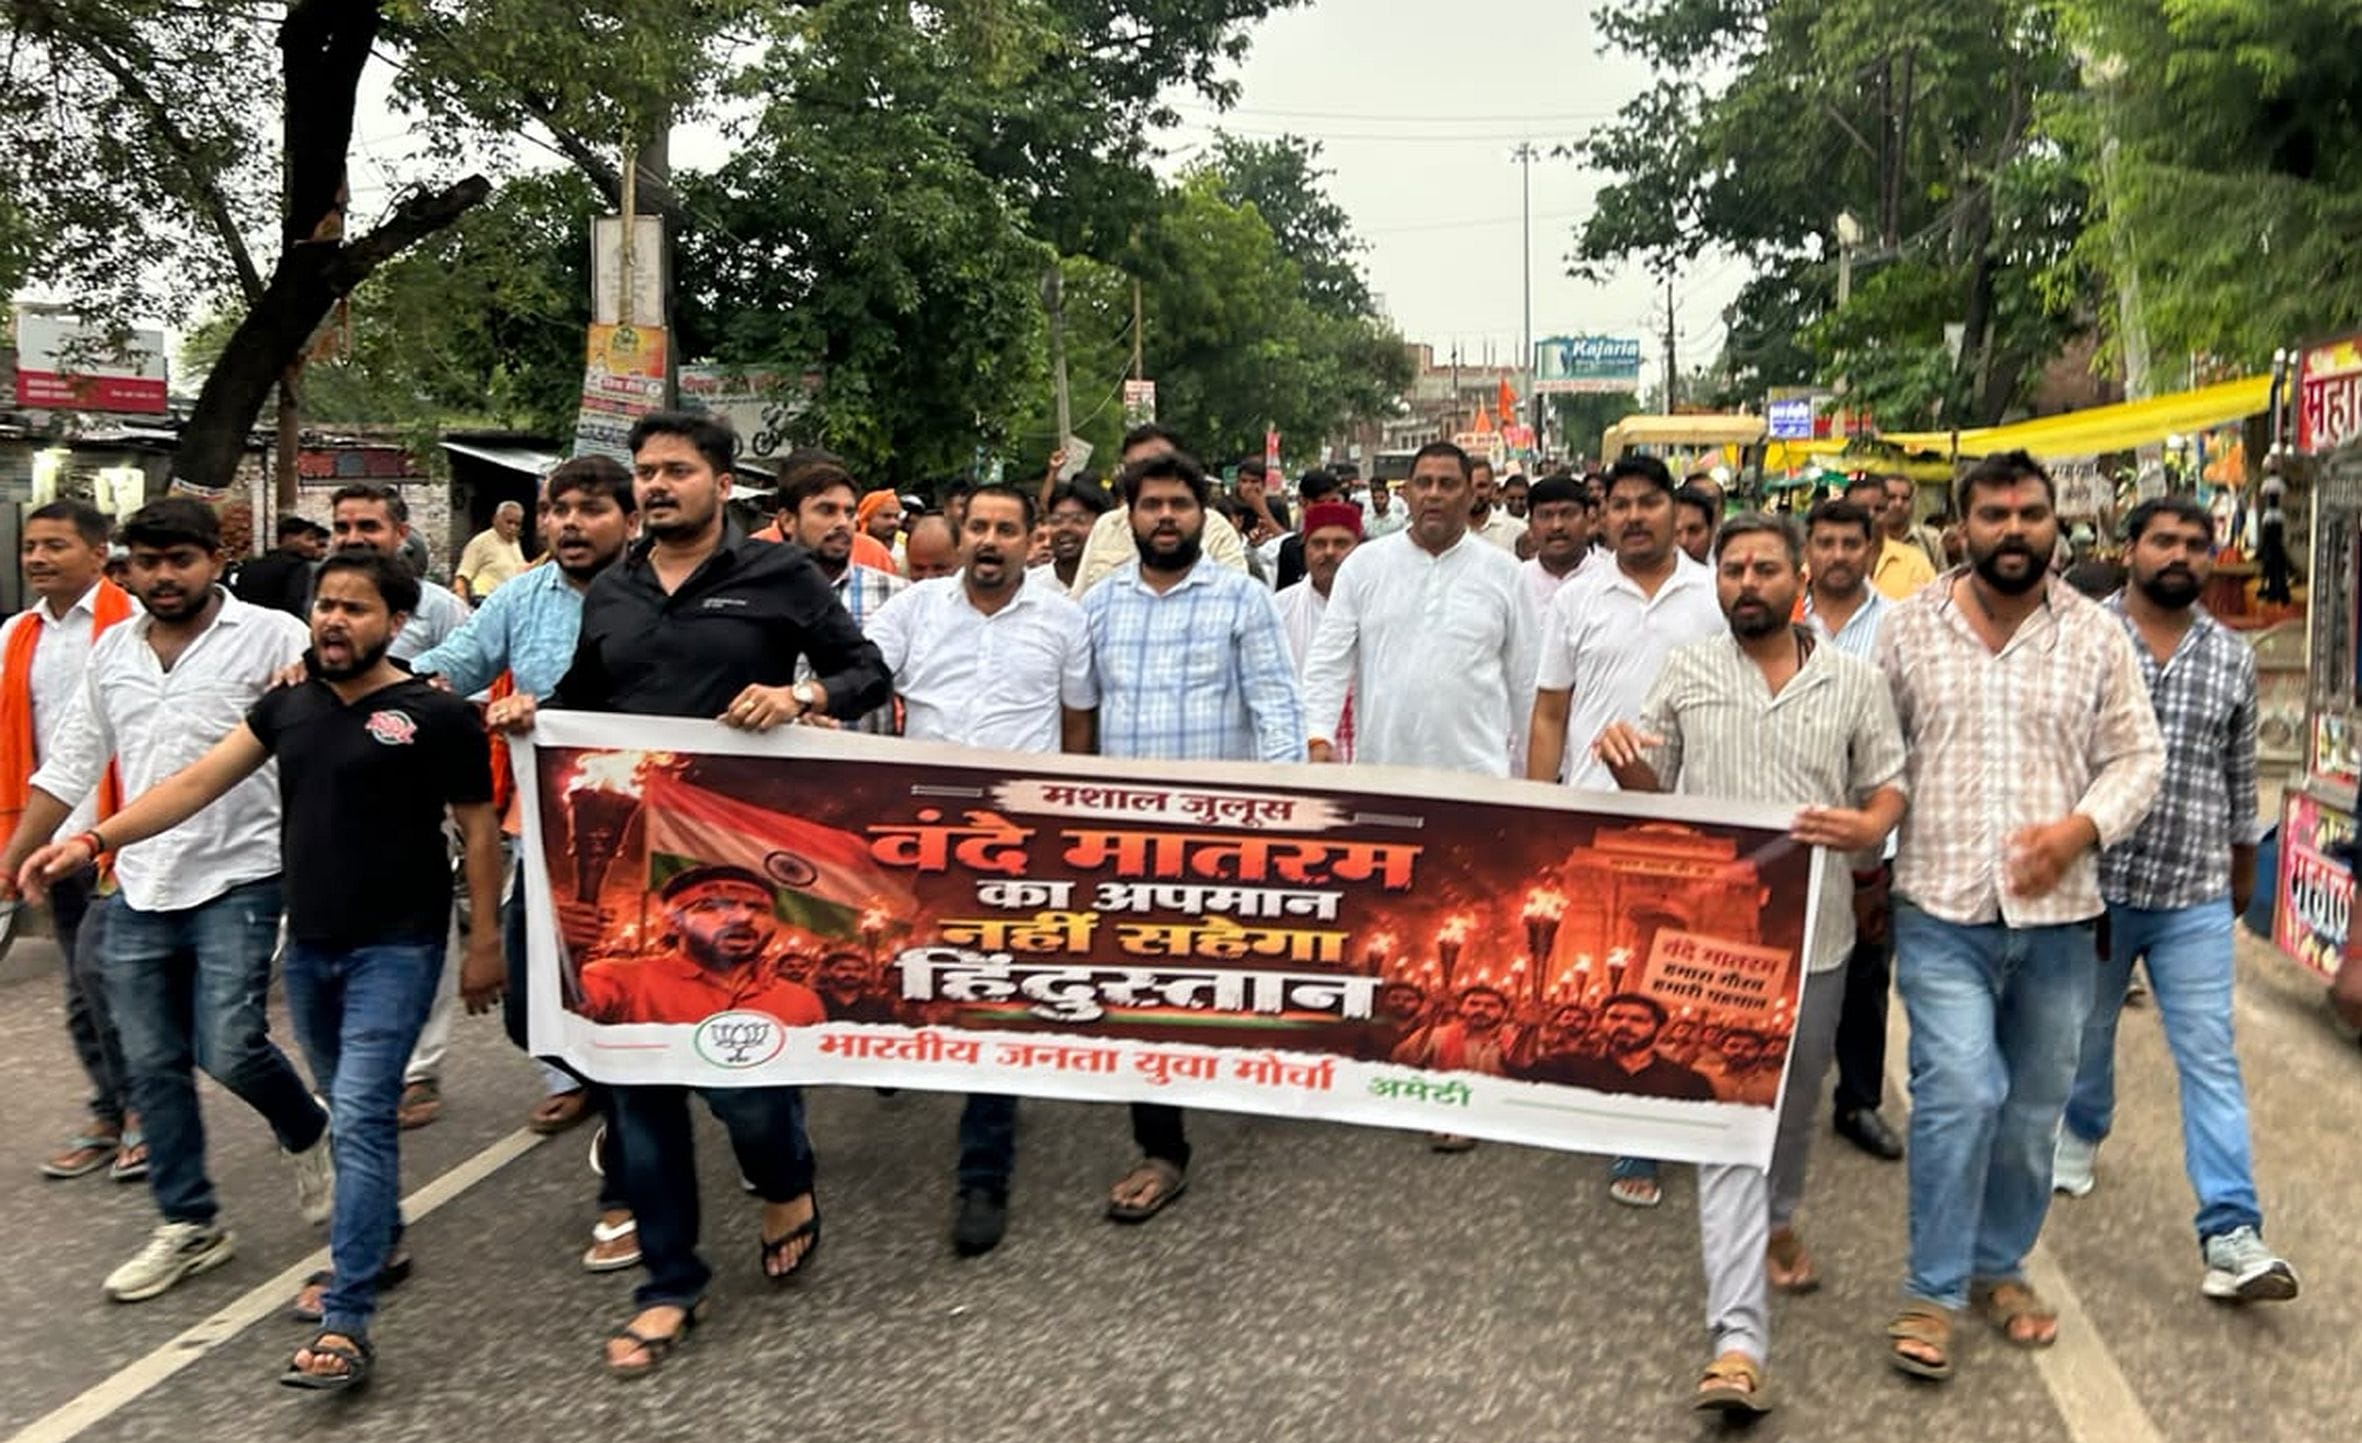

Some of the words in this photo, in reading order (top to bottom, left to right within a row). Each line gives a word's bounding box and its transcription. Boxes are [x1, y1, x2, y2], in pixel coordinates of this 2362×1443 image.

[1573, 340, 1639, 361] Kajaria
[2305, 374, 2362, 440] महा
[1041, 785, 1170, 812] मशाल
[1179, 793, 1296, 827] जुलूस
[867, 808, 1036, 875] वंदे
[1061, 829, 1424, 889] मातरम
[976, 879, 1076, 909] का
[1092, 882, 1344, 920] अपमान
[937, 911, 1100, 952] नहीं
[1116, 914, 1350, 962] सहेगा
[894, 947, 1384, 1022] हिंदुस्तान
[818, 1031, 981, 1065] भारतीय
[996, 1042, 1122, 1073] जनता
[1133, 1051, 1219, 1085] युवा
[1234, 1050, 1338, 1091] मोर्चा
